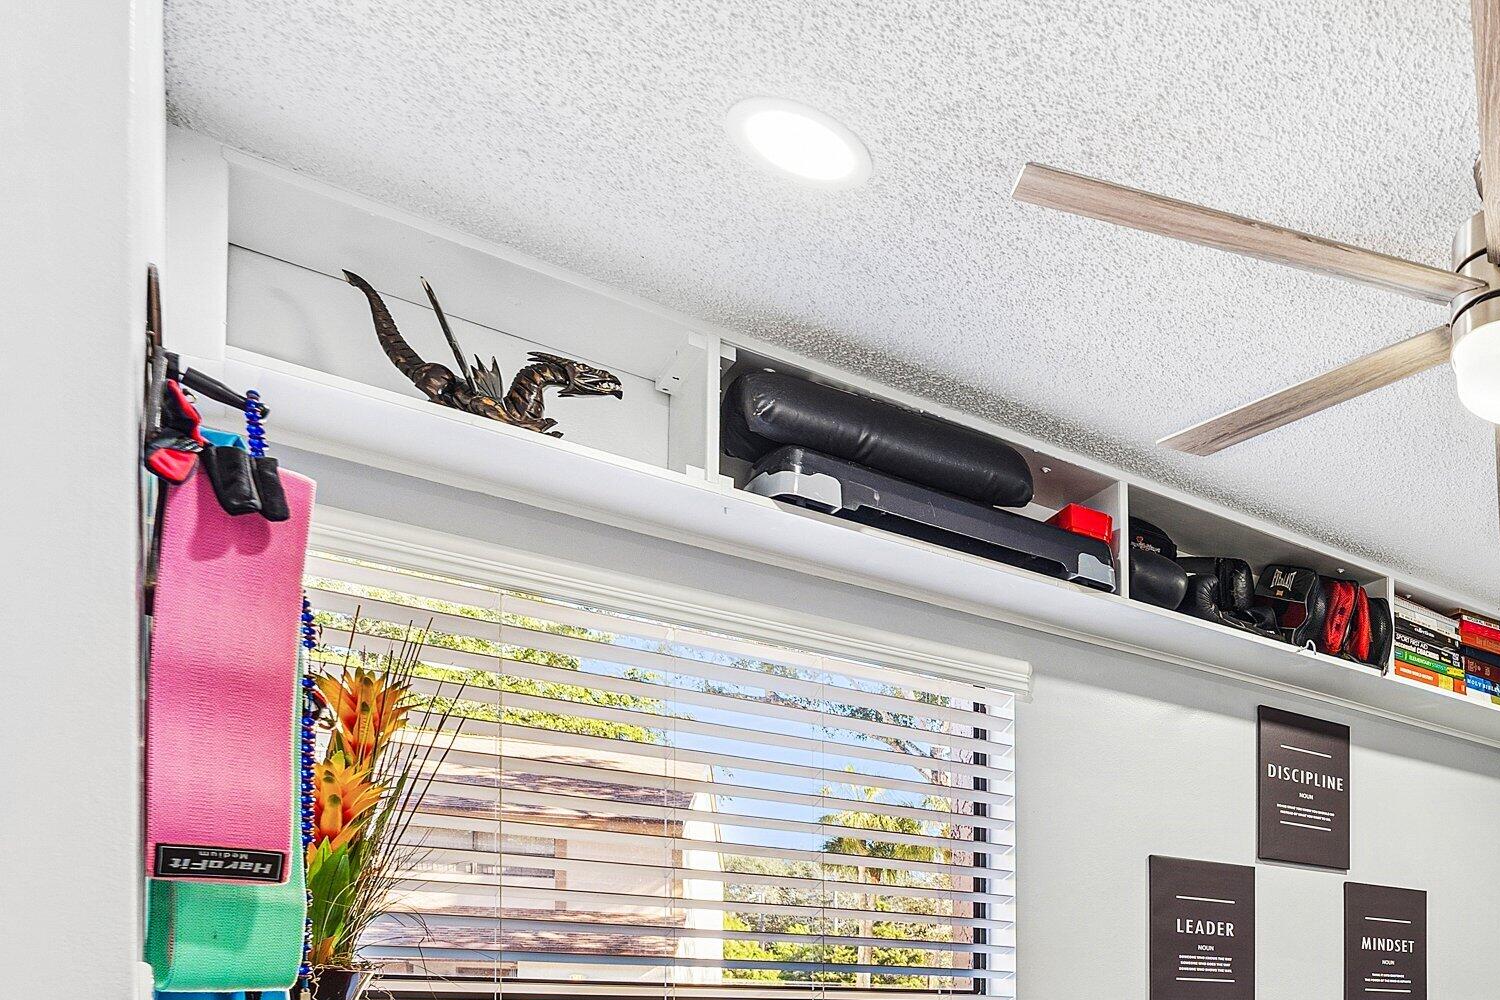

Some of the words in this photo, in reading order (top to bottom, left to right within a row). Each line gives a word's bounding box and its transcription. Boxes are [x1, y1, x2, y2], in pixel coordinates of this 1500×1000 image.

[1268, 764, 1344, 792] DISCIPLINE
[198, 851, 248, 860] Medium
[169, 858, 272, 874] HaroFit
[1176, 918, 1234, 936] LEADER
[1362, 936, 1414, 953] MINDSET
